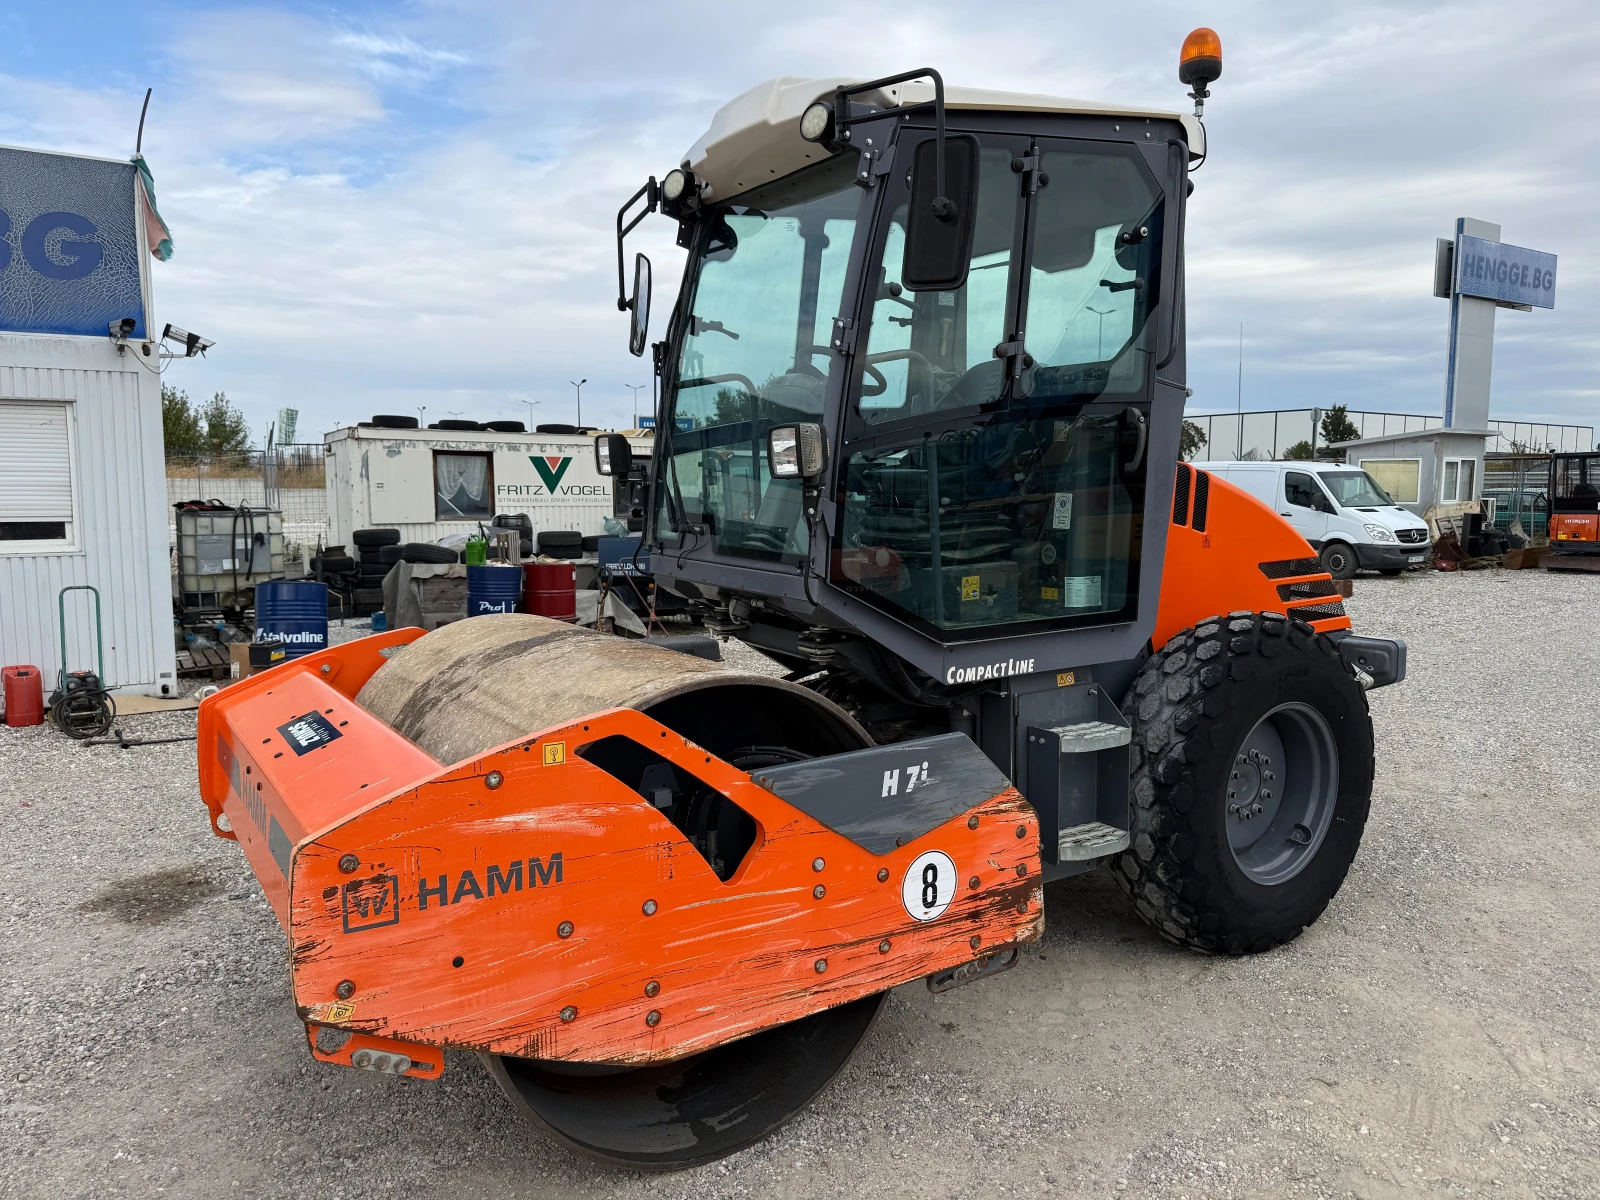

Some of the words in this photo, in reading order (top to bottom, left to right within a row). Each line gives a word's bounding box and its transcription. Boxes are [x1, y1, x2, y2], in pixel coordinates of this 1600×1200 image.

[1464, 254, 1553, 291] HENGGE.BG
[497, 485, 544, 495] FRITZ
[560, 485, 611, 496] VOGEL
[263, 632, 324, 643] Valvoline
[287, 721, 321, 747] SCHULZ
[881, 769, 900, 797] H
[242, 770, 267, 841] HAMM
[418, 852, 563, 911] HAMM
[922, 863, 938, 909] 8
